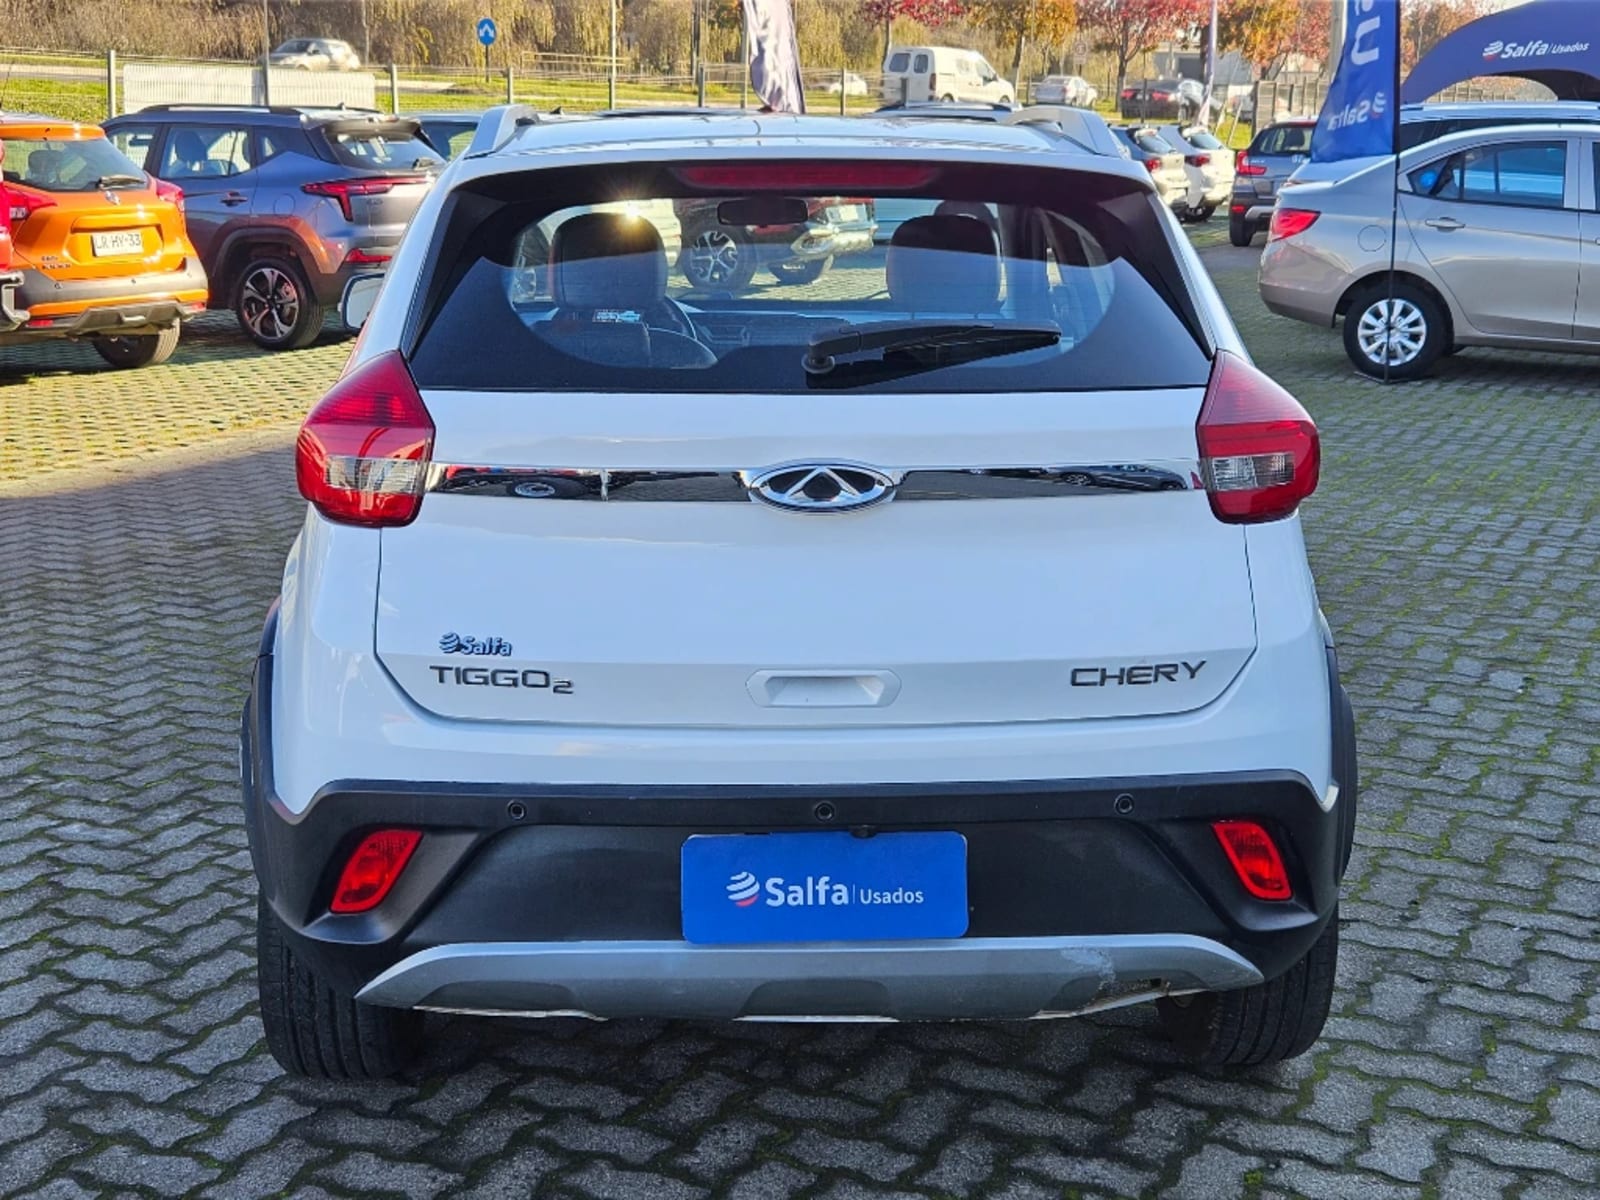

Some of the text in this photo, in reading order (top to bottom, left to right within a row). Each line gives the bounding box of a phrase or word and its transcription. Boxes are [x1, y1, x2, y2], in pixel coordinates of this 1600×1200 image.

[1501, 40, 1590, 58] Salfa Usados
[461, 636, 513, 656] Salfa
[1071, 660, 1207, 687] CHERY
[765, 876, 924, 907] Salfa Usados
